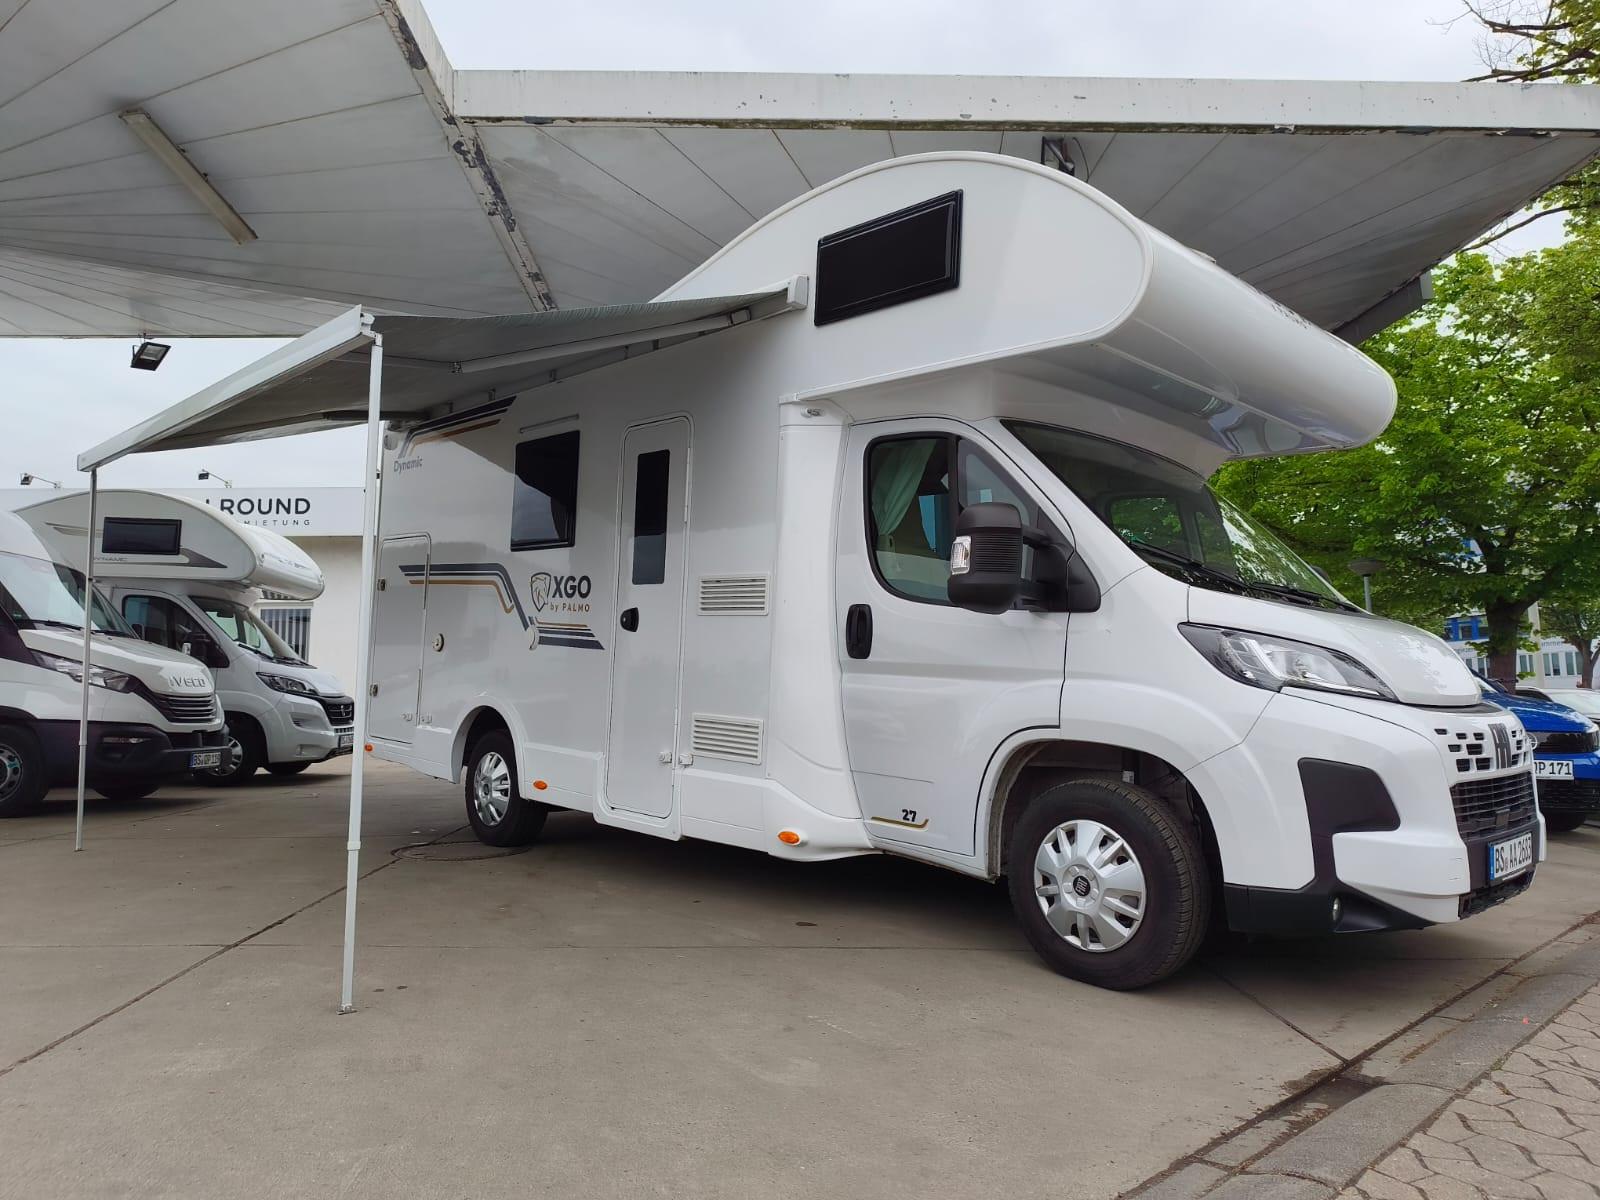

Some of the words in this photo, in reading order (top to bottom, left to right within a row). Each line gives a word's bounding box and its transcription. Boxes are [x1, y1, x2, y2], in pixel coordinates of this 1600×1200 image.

[393, 456, 423, 475] Dynamic
[552, 575, 592, 599] XGO
[550, 602, 559, 612] by
[562, 602, 590, 612] PALMO
[168, 676, 206, 688] IVECO
[1549, 762, 1572, 775] 171
[902, 808, 917, 822] 27
[1495, 846, 1505, 874] BS
